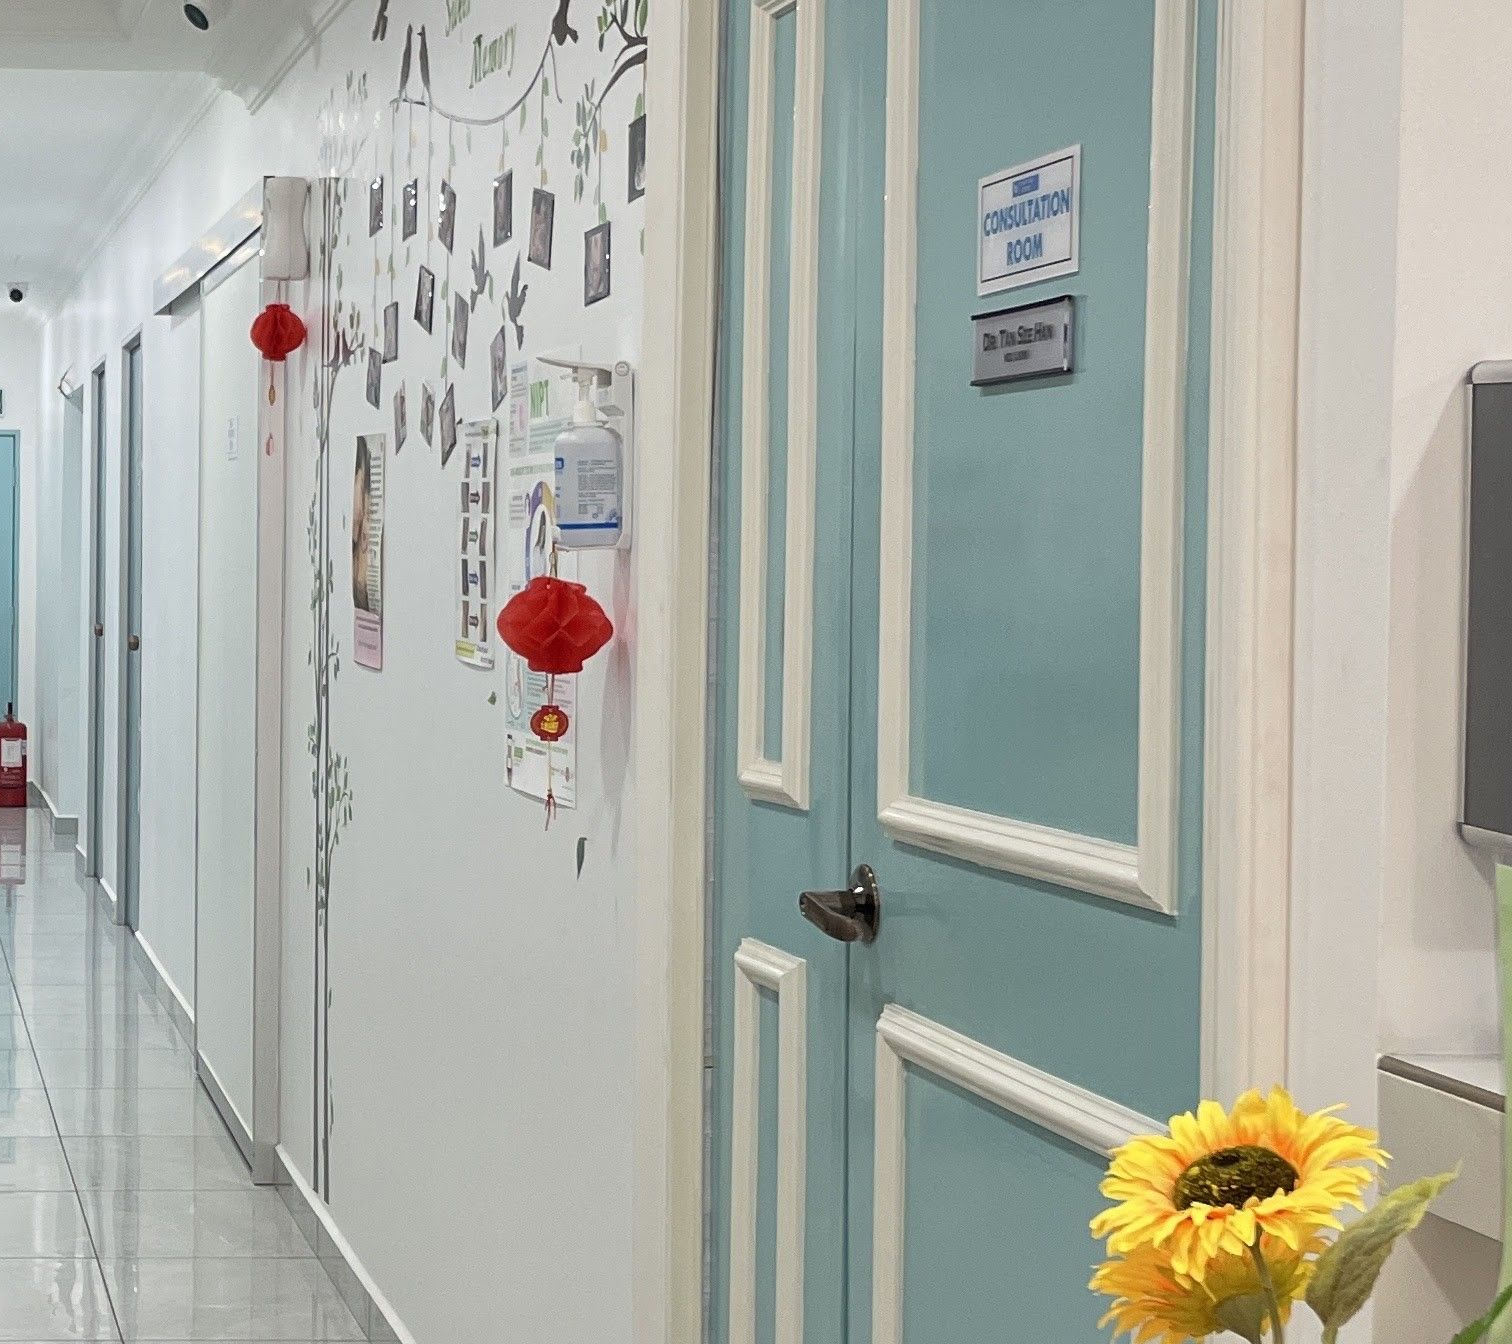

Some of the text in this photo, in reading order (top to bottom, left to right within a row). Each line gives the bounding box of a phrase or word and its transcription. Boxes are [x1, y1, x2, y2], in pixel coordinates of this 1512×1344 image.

[469, 23, 517, 89] Memory
[983, 187, 1070, 237] CONSULTATION
[1006, 233, 1043, 266] ROOM
